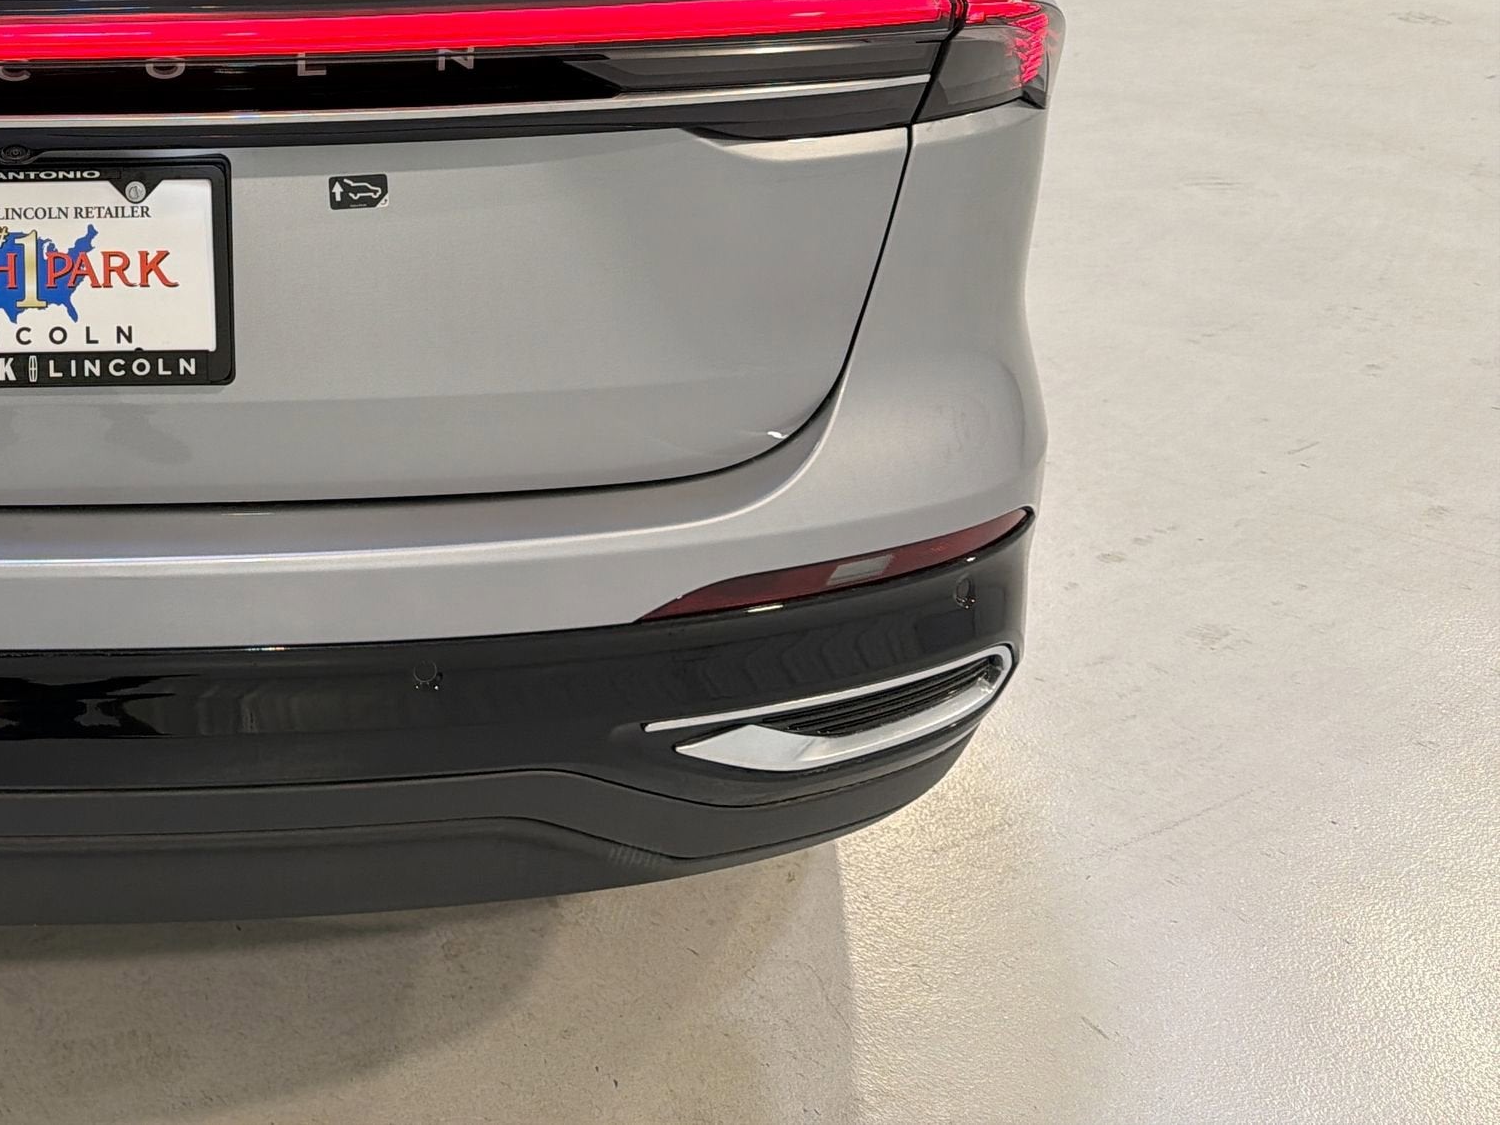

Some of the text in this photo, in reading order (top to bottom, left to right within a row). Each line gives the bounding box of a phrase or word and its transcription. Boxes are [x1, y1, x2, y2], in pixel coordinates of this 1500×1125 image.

[73, 206, 151, 220] RETAILER
[46, 250, 179, 288] PARK
[49, 357, 197, 377] LINCOLN
